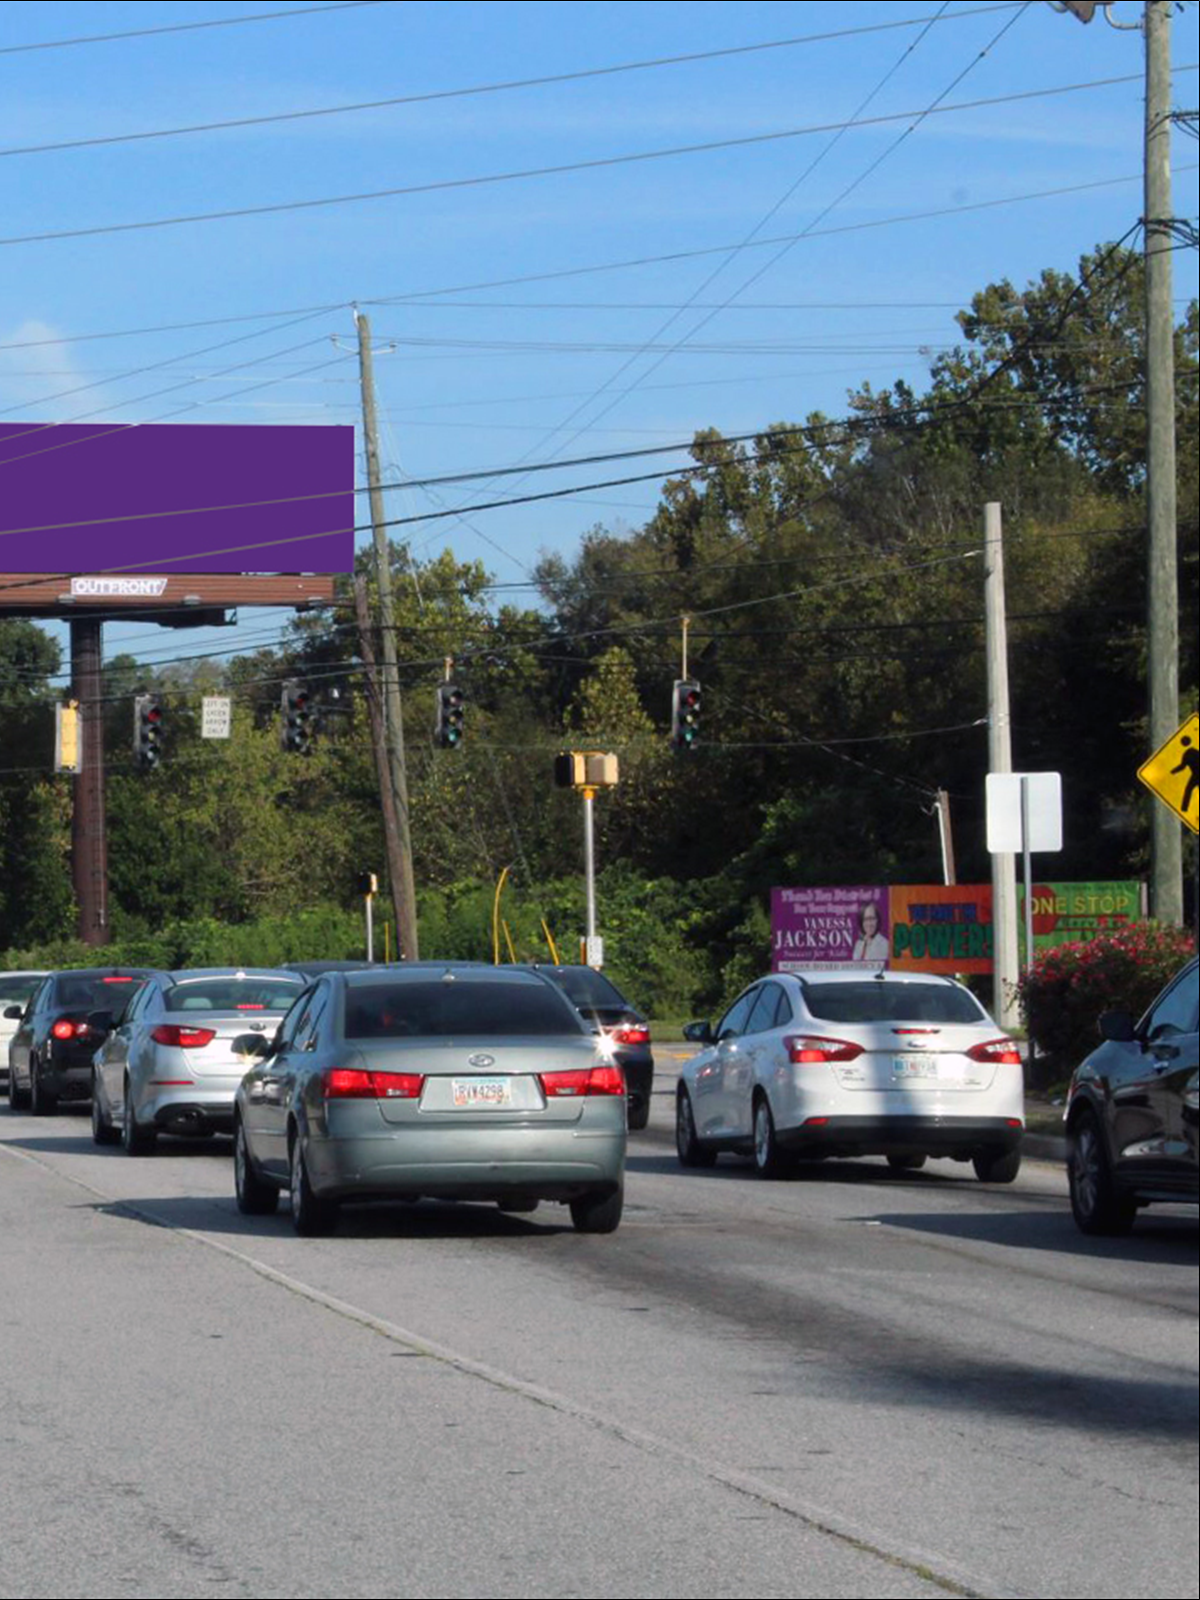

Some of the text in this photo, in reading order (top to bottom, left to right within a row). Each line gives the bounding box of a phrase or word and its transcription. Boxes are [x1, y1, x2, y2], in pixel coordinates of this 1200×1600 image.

[75, 580, 161, 594] OUTFRONT
[1074, 896, 1129, 914] STOP
[804, 917, 853, 930] VANESSA
[775, 930, 853, 949] JACKSON
